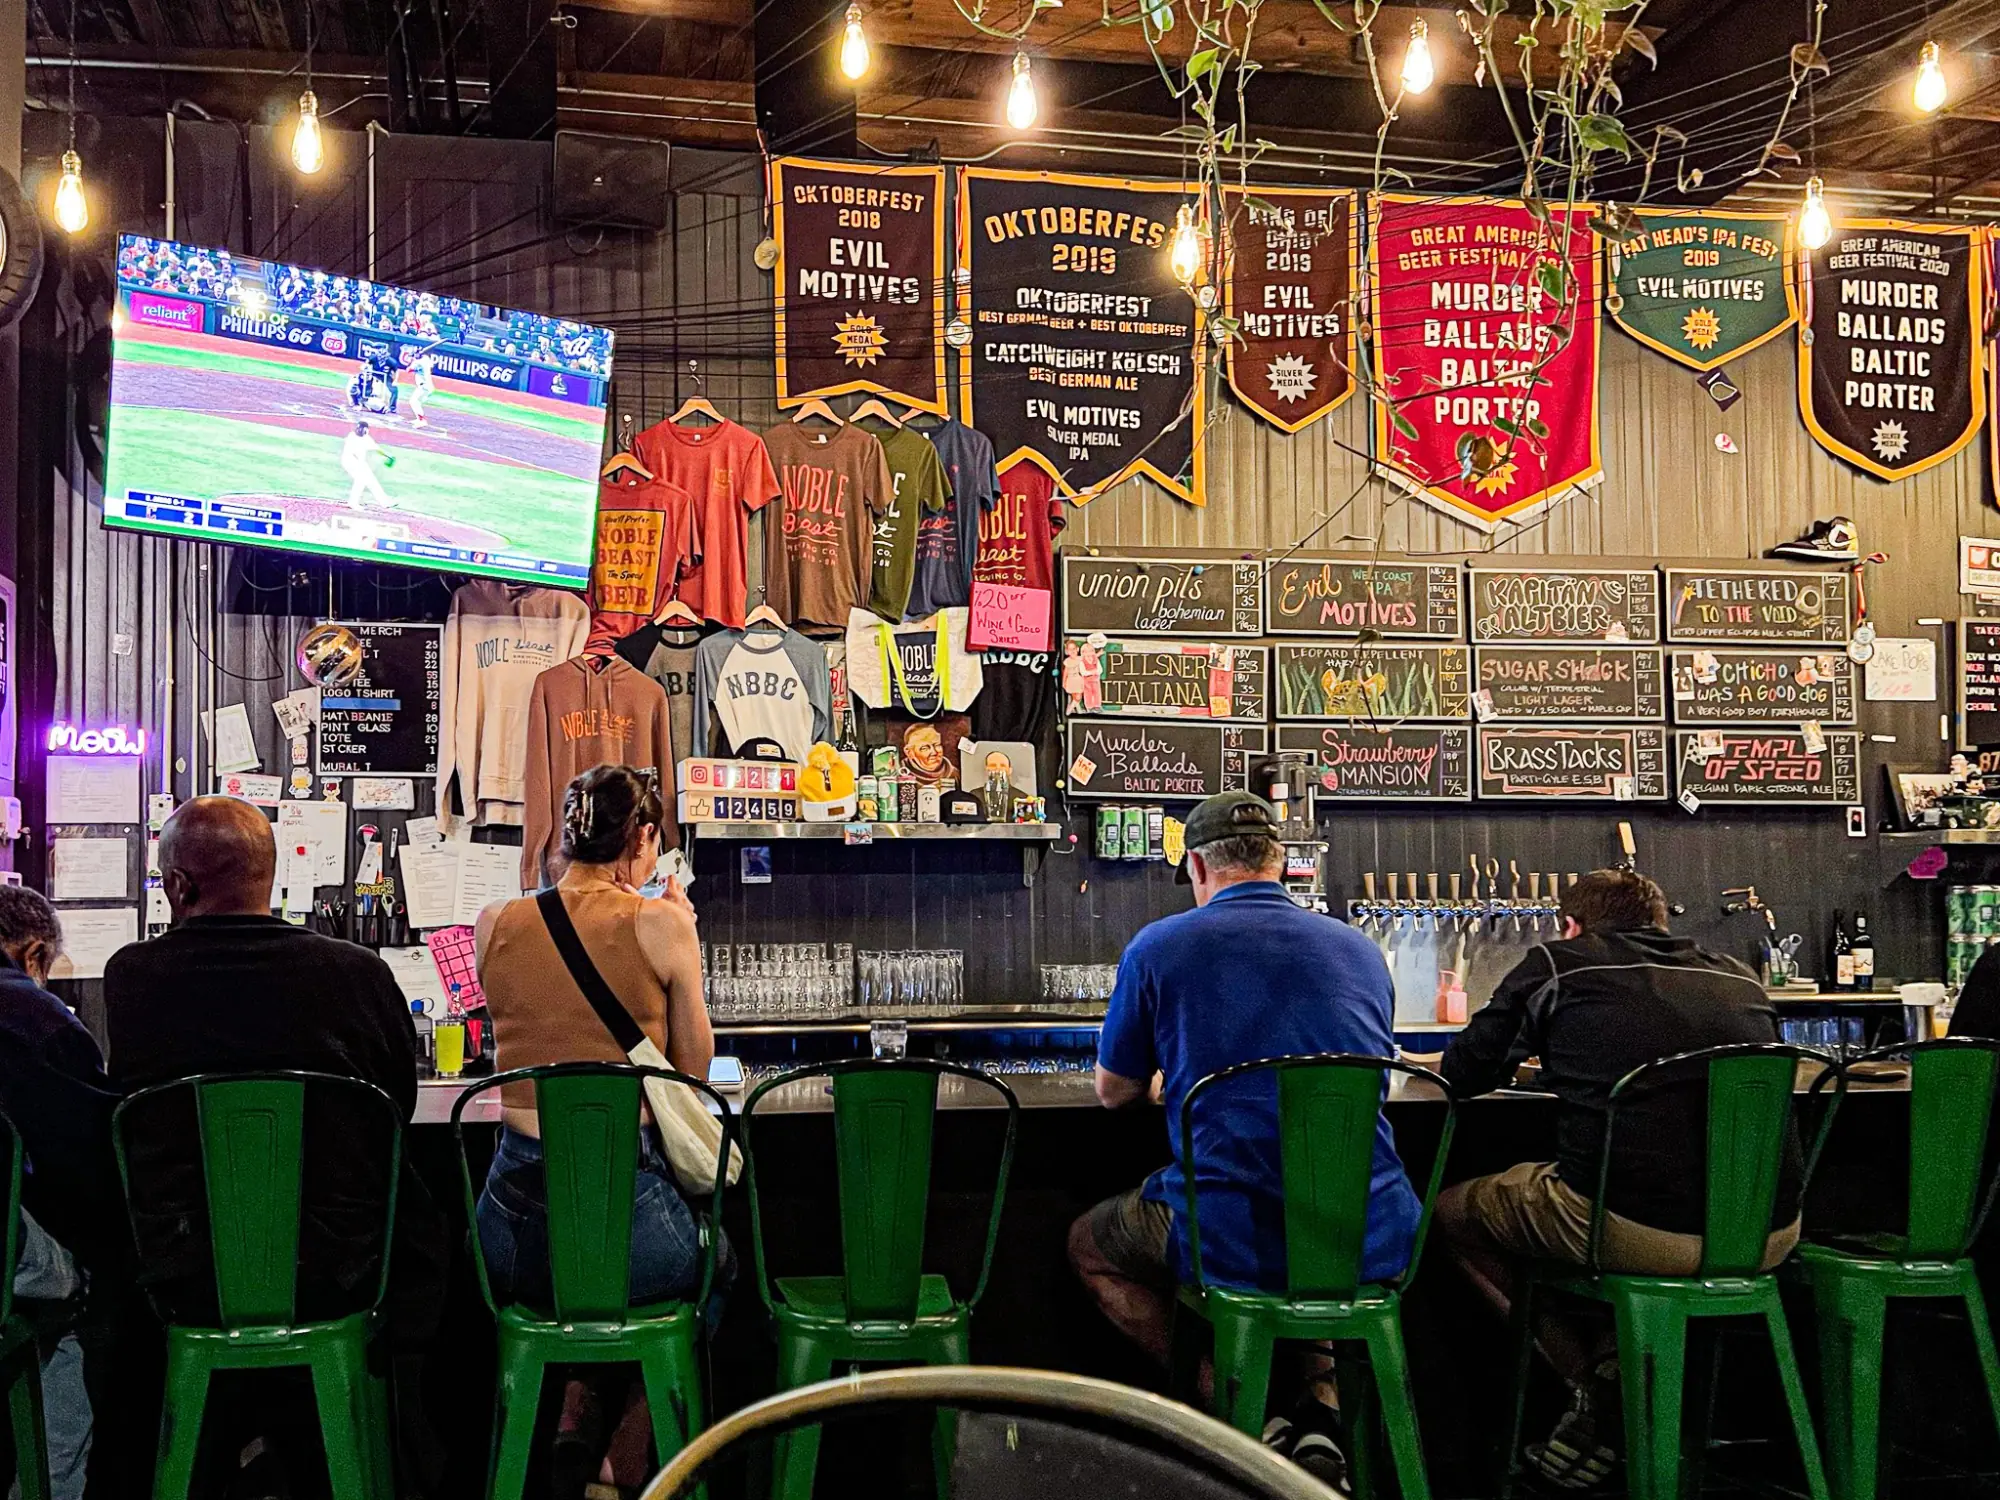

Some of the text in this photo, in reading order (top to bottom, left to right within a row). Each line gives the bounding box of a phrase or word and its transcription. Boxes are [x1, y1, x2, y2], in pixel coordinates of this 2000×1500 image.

[793, 185, 924, 213] OKTOBERFEST
[838, 208, 881, 230] 2018
[1304, 208, 1329, 229] OF
[1410, 225, 1467, 248] GREAT
[1621, 226, 1779, 262] FAT HEAD'S IPA FEST
[829, 238, 889, 269] EVIL
[1052, 243, 1116, 275] 2019
[1683, 249, 1720, 267] 2019
[1841, 237, 1941, 259] GREAT AMERICAN
[1398, 248, 1444, 272] BEER
[1449, 247, 1528, 270] FESTIVAL
[1829, 254, 1950, 277] BEER FESTIVAL 2020
[799, 268, 920, 305] MOTIVES
[1263, 285, 1314, 310] EVIL
[1637, 276, 1765, 302] EVIL MOTIVES
[1841, 278, 1939, 311] MURDER
[1016, 287, 1152, 318] OKTOBERFEST
[1431, 281, 1544, 315] MURDER
[142, 302, 188, 322] reliant
[270, 313, 289, 326] OF
[220, 316, 314, 346] PHILLIPS 66
[978, 310, 1188, 337] BEST GERMAN BEER BEST OKTOBERFEST
[1243, 310, 1341, 339] MOTIVES
[1423, 318, 1550, 351] BALLADS
[1837, 311, 1946, 345] BALLADS
[324, 339, 343, 350] 66
[846, 334, 875, 346] MEDAL
[984, 343, 1107, 370] CATCHWEIGHT
[1850, 346, 1931, 378] BALTIC
[432, 354, 517, 383] PHILLIPS 66
[1028, 366, 1139, 391] BEST GERMAN ALE
[1275, 368, 1304, 378] SILVER
[1441, 358, 1537, 389] BALTIC
[1276, 378, 1304, 388] MEDAL
[1845, 380, 1936, 413] PORTER
[1026, 399, 1141, 430] EVIL MOTIVES
[1434, 396, 1541, 426] PORTER
[1047, 424, 1122, 448] SILVER MEDAL
[1069, 447, 1090, 461] IPA
[781, 463, 850, 518] NOBLE
[183, 511, 195, 525] 2
[265, 523, 274, 535] 1
[1382, 571, 1414, 583] COAST
[1078, 565, 1204, 614] union pils
[1279, 564, 1342, 617] Evil
[1689, 578, 1799, 602] TETHERED
[1159, 599, 1225, 621] bohemian
[1240, 595, 1255, 607] 35
[1135, 606, 1177, 630] lager
[1319, 600, 1417, 627] MOTIVES
[1696, 604, 1720, 623] TO
[1723, 604, 1753, 623] THE
[1761, 605, 1798, 623] VOID
[359, 626, 402, 636] MERCH
[424, 651, 437, 660] 30
[425, 640, 438, 650] 25
[475, 637, 510, 669] NOBLE
[1290, 648, 1349, 660] LEOPARD
[424, 660, 438, 669] 22
[1108, 653, 1207, 680] PILSNER
[1445, 660, 1463, 671] 6.6
[1480, 659, 1553, 682] SUGAR
[322, 688, 351, 698] LOGO
[426, 680, 439, 689] 15
[426, 691, 439, 699] 22
[724, 671, 798, 701] NBBC
[1101, 680, 1207, 706] ITALIANA
[1696, 686, 1733, 704] WAS
[1737, 685, 1752, 704] A
[1756, 685, 1797, 703] GOOD
[431, 701, 437, 710] 8
[1514, 695, 1594, 706] LIGHT LAGER
[1687, 706, 1695, 716] A
[1696, 705, 1721, 716] VERY
[1722, 706, 1745, 717] GOOD
[1747, 706, 1769, 717] BOY
[321, 722, 350, 732] PINT
[357, 723, 391, 732] GLASS
[425, 713, 438, 722] 28
[322, 733, 438, 744] TOTE 25
[1081, 728, 1175, 755] Murder
[430, 746, 435, 755] 1
[321, 762, 437, 772] MURAL T 25
[1102, 752, 1204, 780] Ballads
[1226, 758, 1242, 772] 39
[1341, 764, 1429, 786] MANSION
[1704, 760, 1822, 781] OF SPEED
[1124, 777, 1206, 793] BALTIC PORTER
[1686, 783, 1729, 794] BELGIAN
[1733, 784, 1765, 794] DARK
[1766, 784, 1809, 794] STRONG
[1811, 784, 1834, 794] ALE
[1288, 857, 1315, 868] DOLLY
